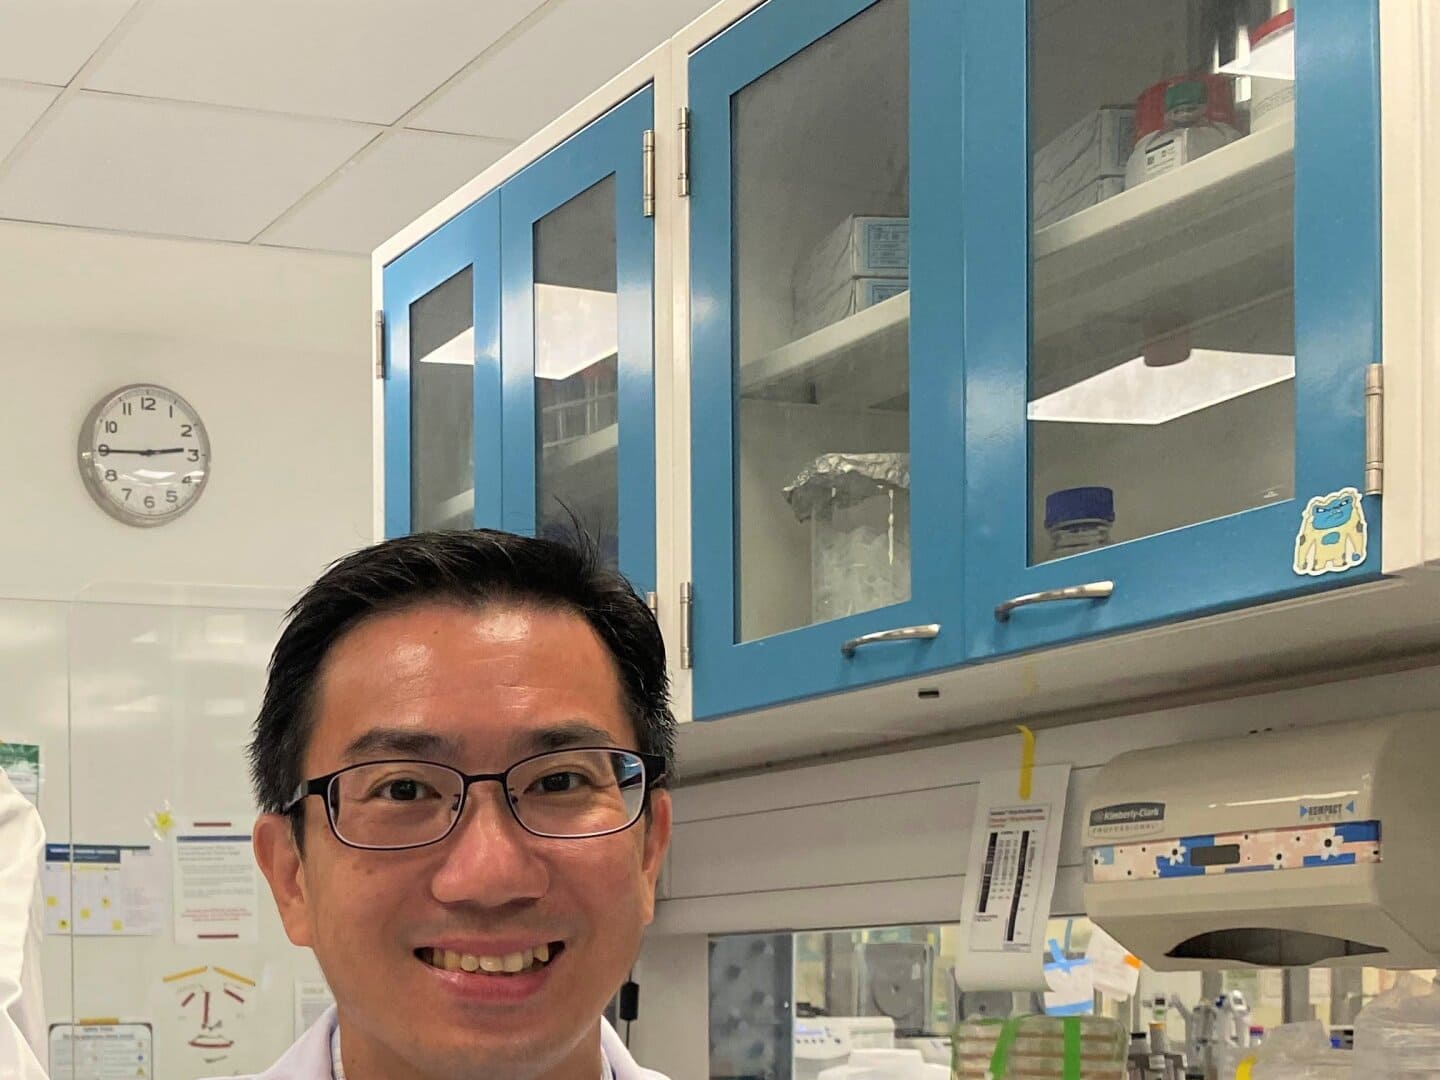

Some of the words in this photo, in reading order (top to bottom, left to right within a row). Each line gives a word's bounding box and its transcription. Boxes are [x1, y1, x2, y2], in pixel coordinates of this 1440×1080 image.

[122, 402, 132, 416] 11
[141, 396, 157, 411] 12
[105, 420, 118, 434] 10
[181, 424, 193, 438] 2
[98, 443, 110, 457] 9
[187, 448, 200, 462] 3
[105, 469, 118, 482] 8
[181, 475, 193, 485] 4
[122, 488, 132, 501] 7
[166, 490, 178, 503] 5
[144, 496, 155, 509] 6
